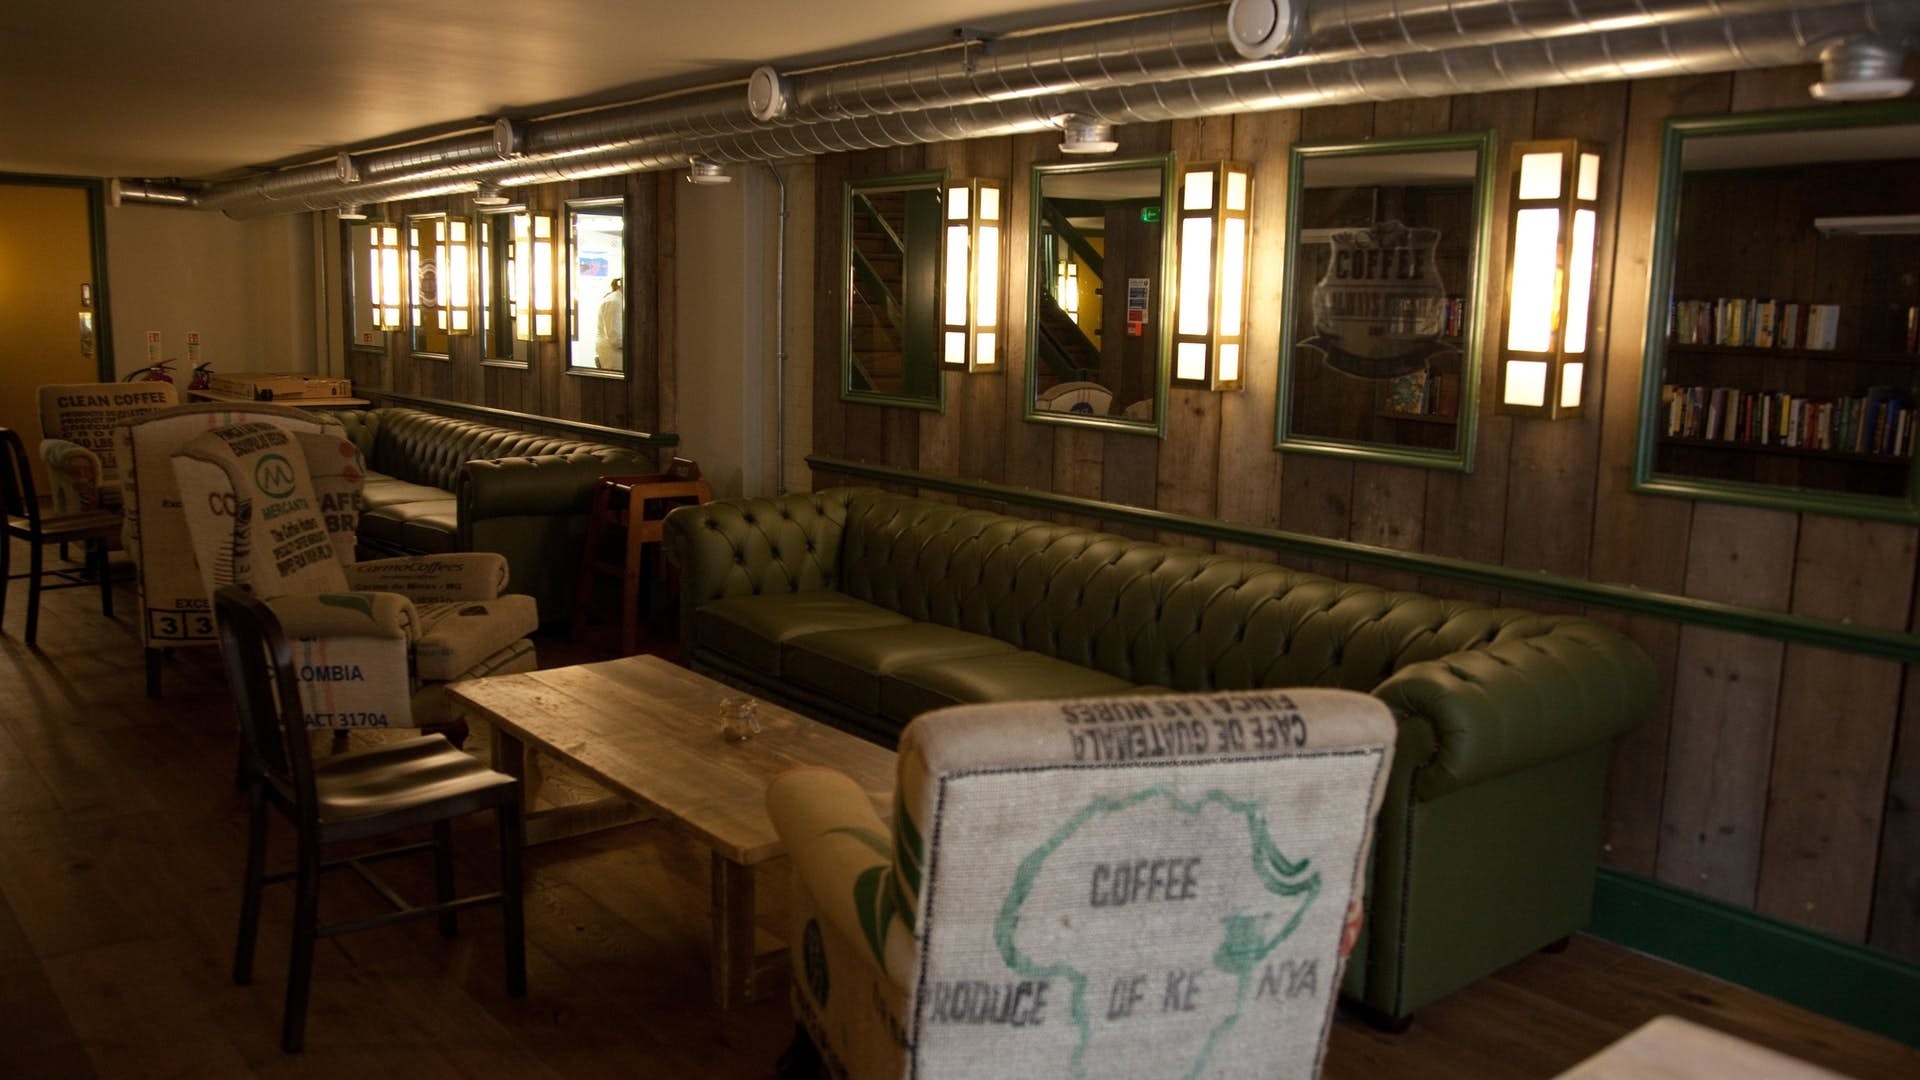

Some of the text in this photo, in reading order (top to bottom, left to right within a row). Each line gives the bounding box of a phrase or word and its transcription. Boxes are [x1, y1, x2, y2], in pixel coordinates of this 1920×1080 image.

[57, 392, 167, 409] CLEAN COFFEE
[339, 712, 388, 727] 31704
[1067, 714, 1308, 762] CAFE DE GUATEMALA
[1089, 857, 1201, 908] COFFEE
[1106, 974, 1148, 1021] OF
[1163, 966, 1203, 1014] KE
[1257, 958, 1320, 1000] NYA
